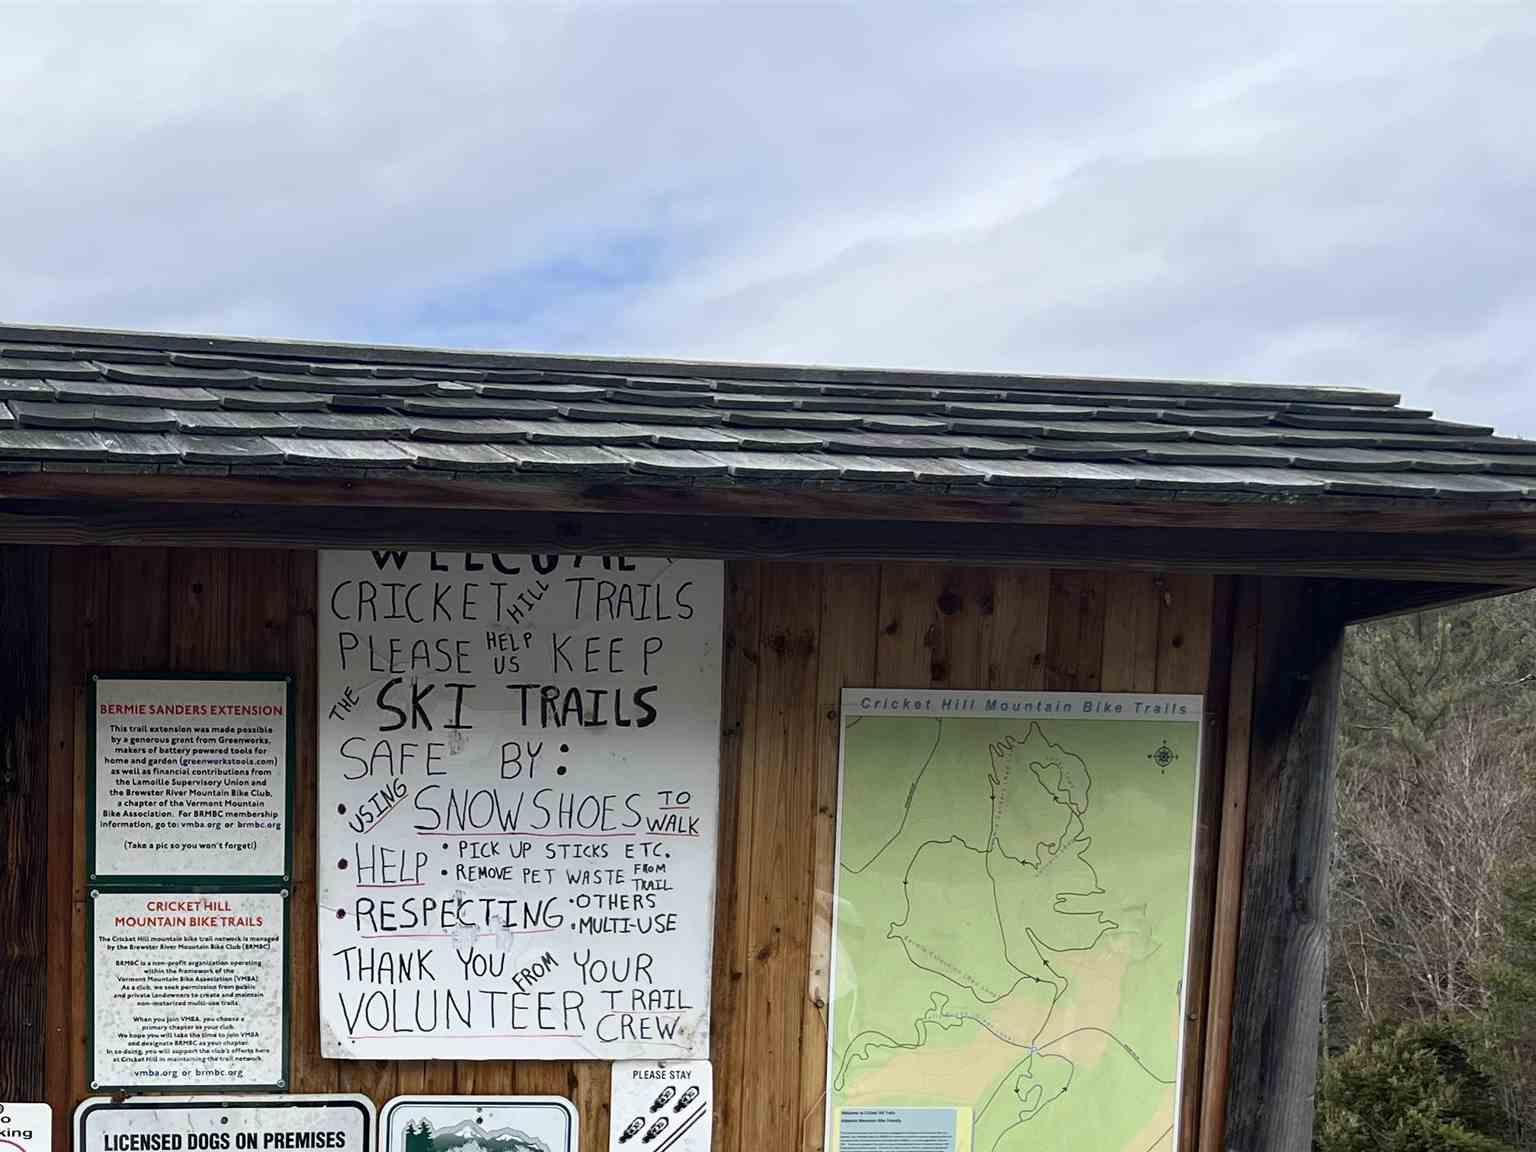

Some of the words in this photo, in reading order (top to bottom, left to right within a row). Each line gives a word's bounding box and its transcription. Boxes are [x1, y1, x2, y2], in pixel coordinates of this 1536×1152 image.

[331, 580, 508, 623] CRICKET
[507, 580, 549, 624] HILL
[565, 578, 694, 621] TRAILS
[485, 631, 533, 651] HELP
[338, 632, 472, 674] PLEASE
[553, 632, 663, 674] KEEP
[494, 656, 519, 673] US
[100, 704, 145, 714] BERMIE
[150, 705, 207, 715] SANDERS
[211, 705, 283, 716] EXTENSION
[329, 686, 359, 721] THE
[376, 678, 476, 731] SKI
[506, 684, 658, 728] TRAILS
[860, 697, 930, 710] Cricket
[941, 699, 975, 711] Hill
[985, 699, 1072, 713] Mountain
[1082, 701, 1122, 713] Bike
[1134, 702, 1187, 715] Trails
[110, 725, 126, 733] This
[129, 725, 147, 733] trail
[212, 726, 235, 734] made
[237, 726, 273, 735] possible
[339, 738, 447, 780] SAFE
[501, 742, 569, 779] BY:
[349, 778, 407, 833] USING
[658, 791, 691, 805] TO
[414, 784, 642, 833] SNOWSHOES
[645, 814, 700, 835] WALK
[124, 841, 146, 850] (Take
[156, 842, 168, 851] pic
[182, 843, 196, 851] you
[225, 841, 256, 851] forget!)
[355, 842, 428, 884] HELP
[459, 841, 501, 859] PICK
[510, 842, 532, 859] UP
[546, 843, 608, 859] STICKS
[625, 842, 671, 859] ETC.
[633, 863, 666, 873] FROM
[456, 866, 513, 881] REMOVE
[523, 868, 556, 884] PET
[566, 869, 625, 884] WASTE
[632, 878, 673, 891] TRAIL
[147, 901, 200, 912] CRICKET
[203, 901, 231, 911] HILL
[574, 894, 656, 909] OTHERS
[115, 917, 186, 927] MOUNTAIN
[190, 917, 217, 927] BIKE
[220, 917, 263, 927] TRAILS
[355, 897, 564, 932] RESPECTING
[579, 914, 678, 934] MULTI-USE
[333, 946, 436, 985] THANK
[456, 946, 506, 977] YOU
[512, 951, 560, 992] FROM
[573, 949, 654, 984] YOUR
[600, 988, 693, 1010] TRAIL
[339, 988, 585, 1035] VOLUNTEER
[596, 1014, 680, 1043] CREW
[134, 1069, 178, 1078] vmba.org
[196, 1069, 243, 1078] brmbc.org
[633, 1070, 666, 1080] PLEASE
[670, 1070, 692, 1080] STAY
[104, 1133, 182, 1152] LICENSED
[188, 1132, 230, 1150] DOGS
[236, 1131, 257, 1149] ON
[263, 1131, 345, 1149] PREMISES
